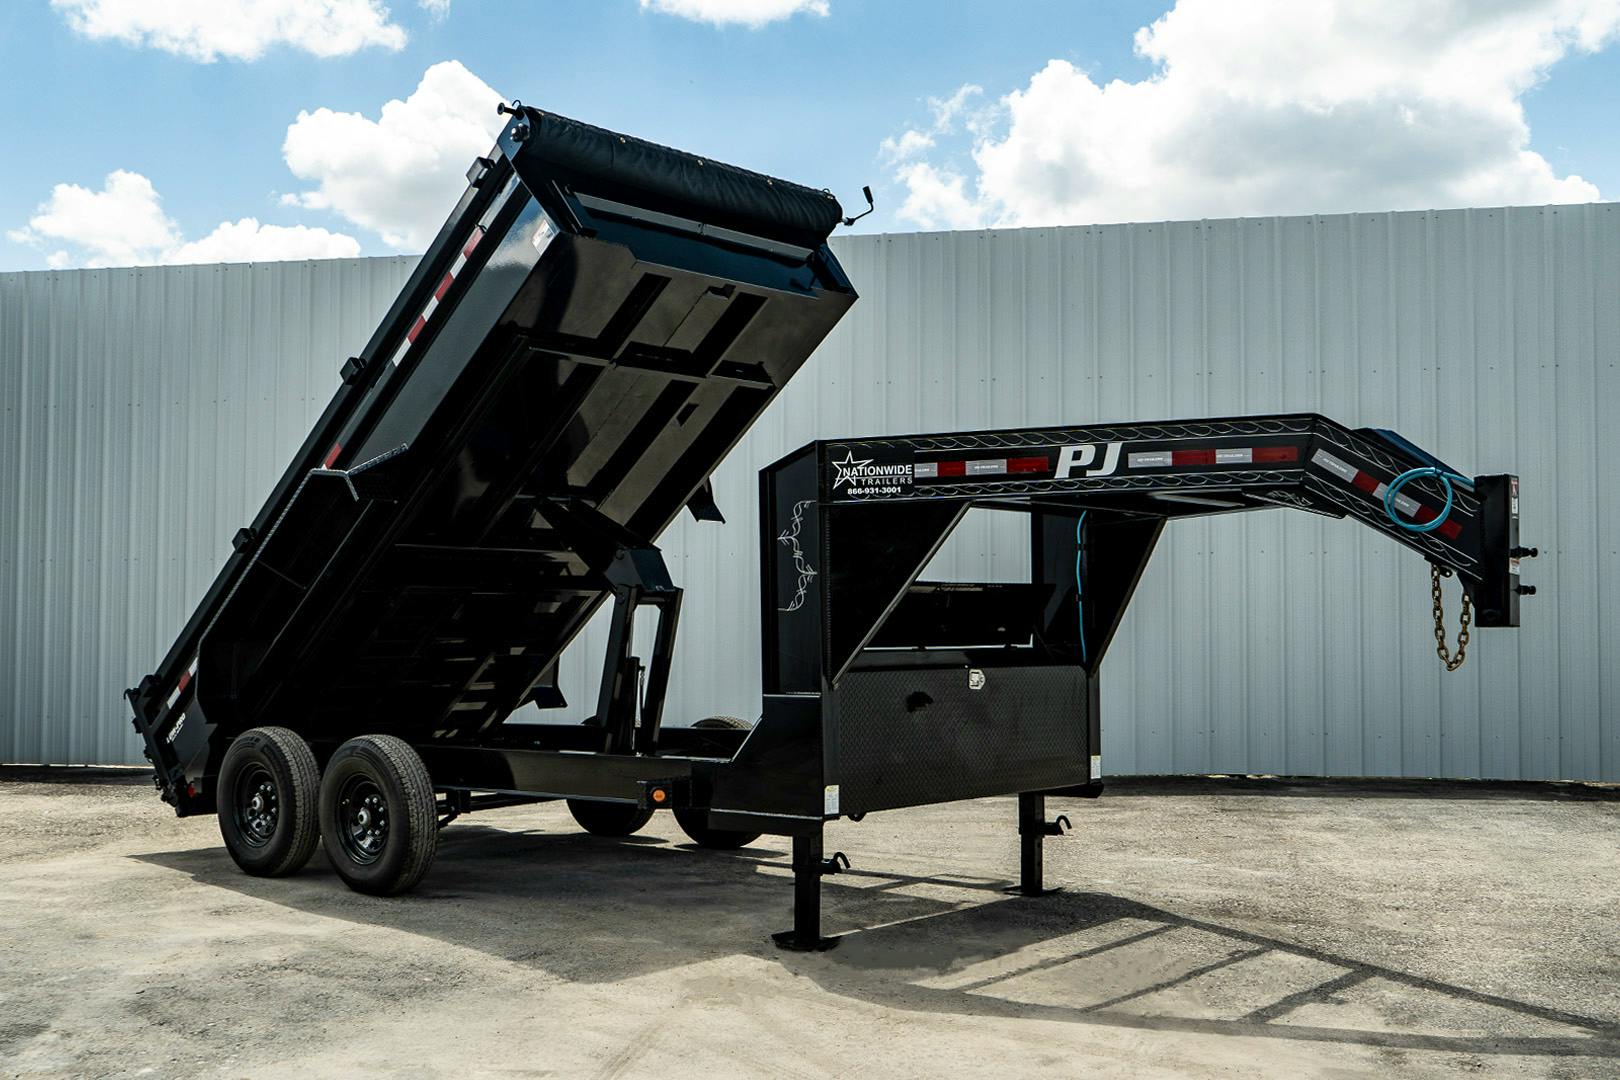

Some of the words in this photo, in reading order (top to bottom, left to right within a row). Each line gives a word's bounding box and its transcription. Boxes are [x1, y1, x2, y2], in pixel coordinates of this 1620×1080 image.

[1054, 442, 1123, 479] PJ
[843, 465, 913, 477] NATIONWIDE
[861, 477, 913, 486] TRAILERS
[847, 486, 902, 495] 866-931-3001
